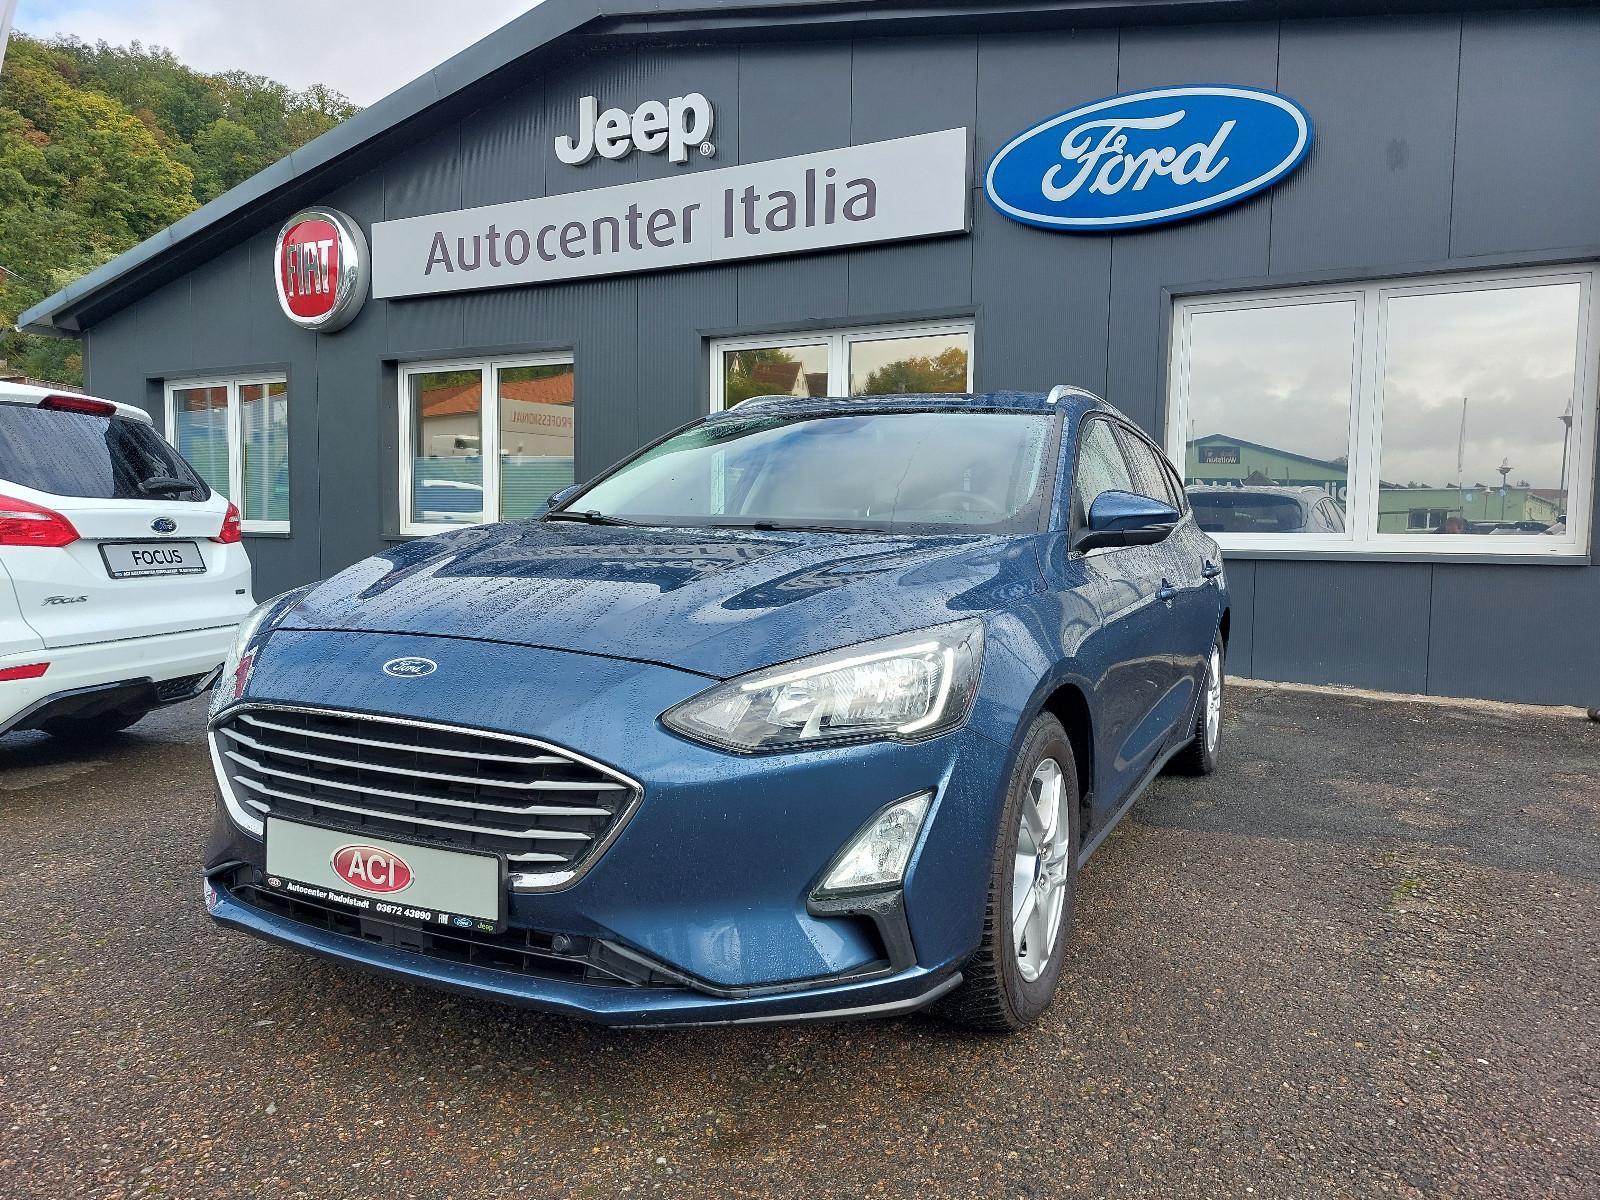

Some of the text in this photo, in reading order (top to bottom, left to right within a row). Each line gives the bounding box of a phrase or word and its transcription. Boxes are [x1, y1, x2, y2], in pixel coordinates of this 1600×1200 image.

[555, 93, 713, 165] Jeep
[1041, 110, 1237, 202] Ford
[424, 167, 878, 276] Autocenter Italia
[286, 239, 334, 297] FIAT
[131, 549, 183, 566] FOCUS
[287, 882, 327, 899] Autocenter
[347, 850, 396, 888] ACI
